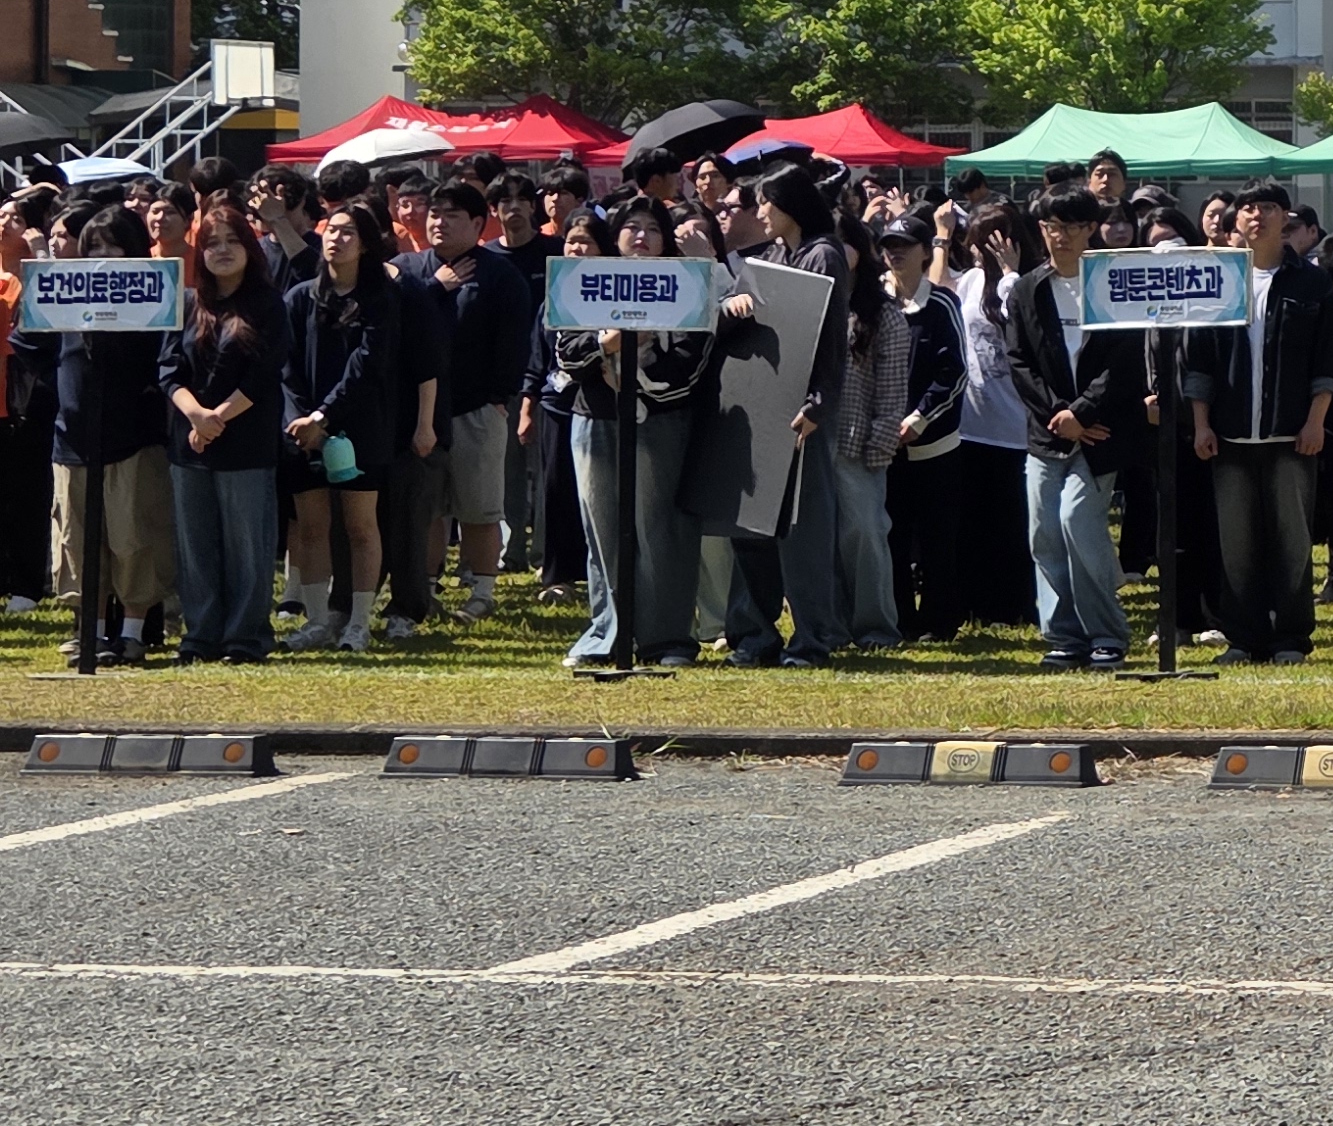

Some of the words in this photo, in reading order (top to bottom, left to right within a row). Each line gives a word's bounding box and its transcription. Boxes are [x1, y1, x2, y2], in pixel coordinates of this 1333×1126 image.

[37, 270, 165, 304] 보건의료행정과
[580, 273, 679, 303] 뷰티미용과
[1108, 265, 1224, 302] 웹툰콘텐츠과
[951, 754, 976, 767] STOP
